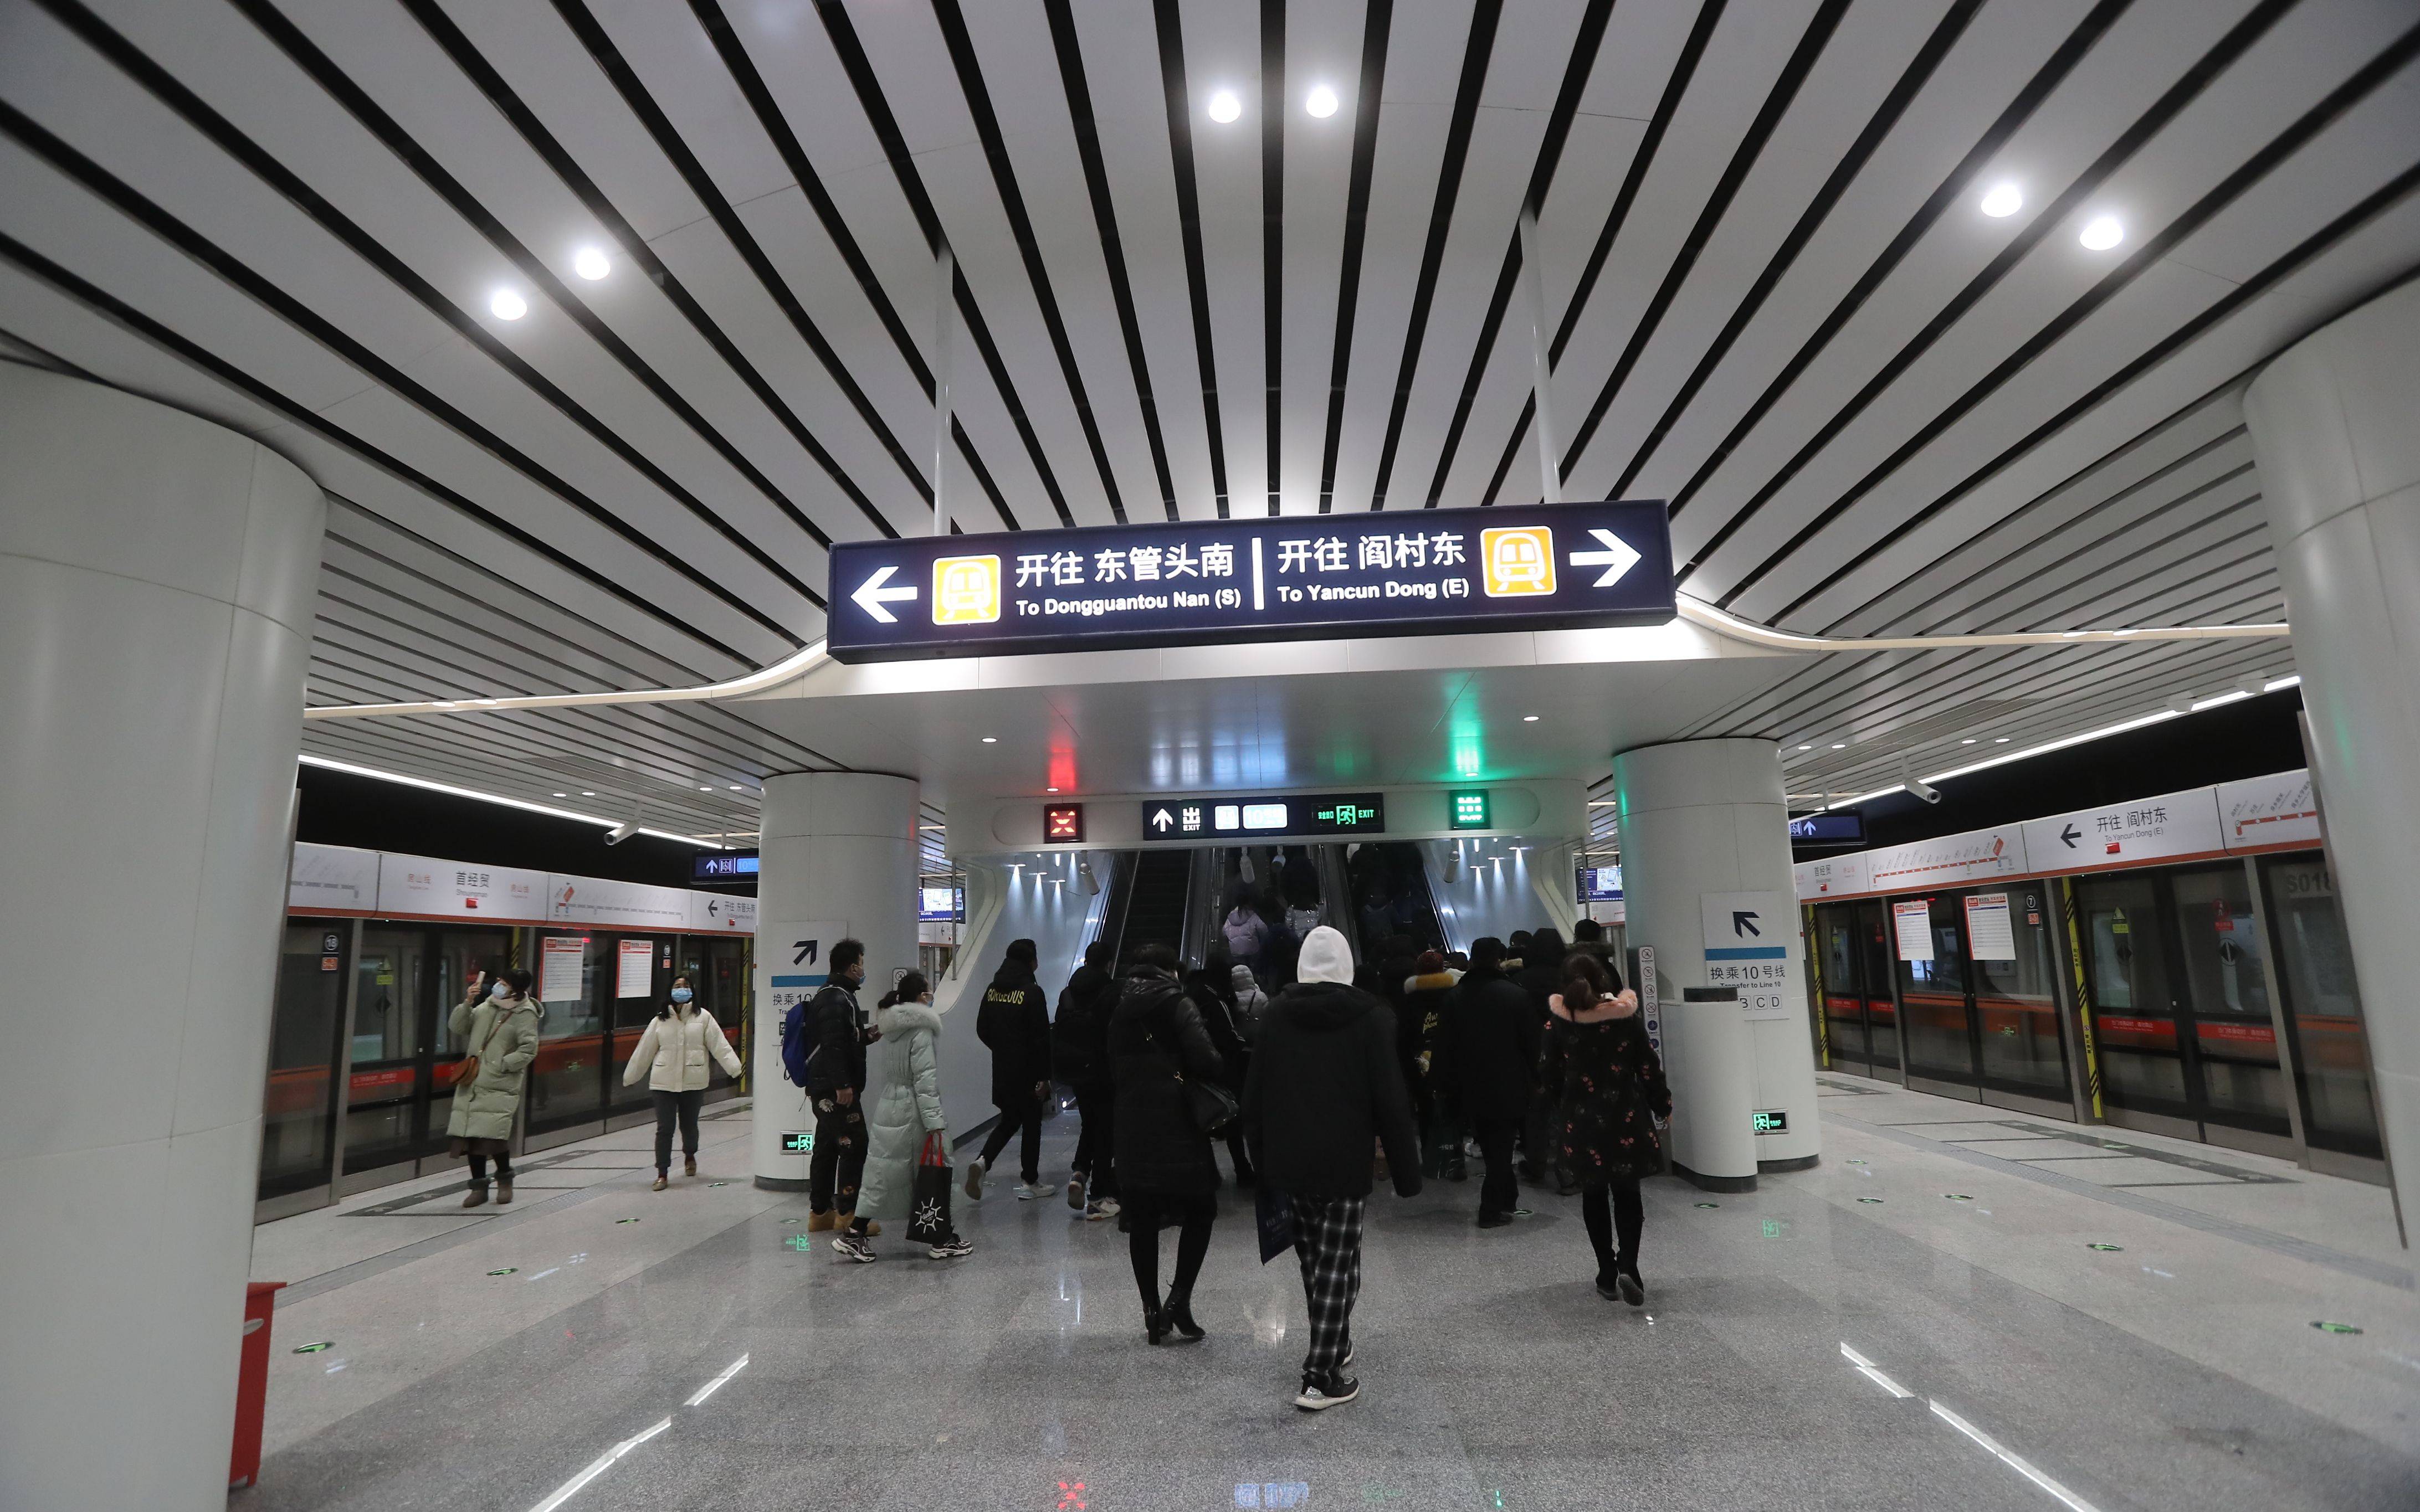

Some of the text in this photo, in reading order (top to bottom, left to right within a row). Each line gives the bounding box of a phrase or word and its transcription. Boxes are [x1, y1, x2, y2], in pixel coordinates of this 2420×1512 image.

[1277, 532, 1467, 574] 开往 阎村东
[1016, 542, 1234, 588] 开往 东管头南
[1277, 578, 1470, 602] To Yancun Dong (E)
[1016, 588, 1242, 616] To Dongguantou Nan (S)
[1183, 807, 1201, 824] 出
[1358, 809, 1374, 818] EXIT
[2096, 807, 2167, 832] 开往 阎村东
[2113, 832, 2135, 841] Yancun
[2136, 830, 2152, 838] Dong
[2154, 827, 2163, 836] (E)
[456, 871, 490, 888] 首经贸
[1756, 997, 1765, 1008] C
[1772, 996, 1780, 1007] D
